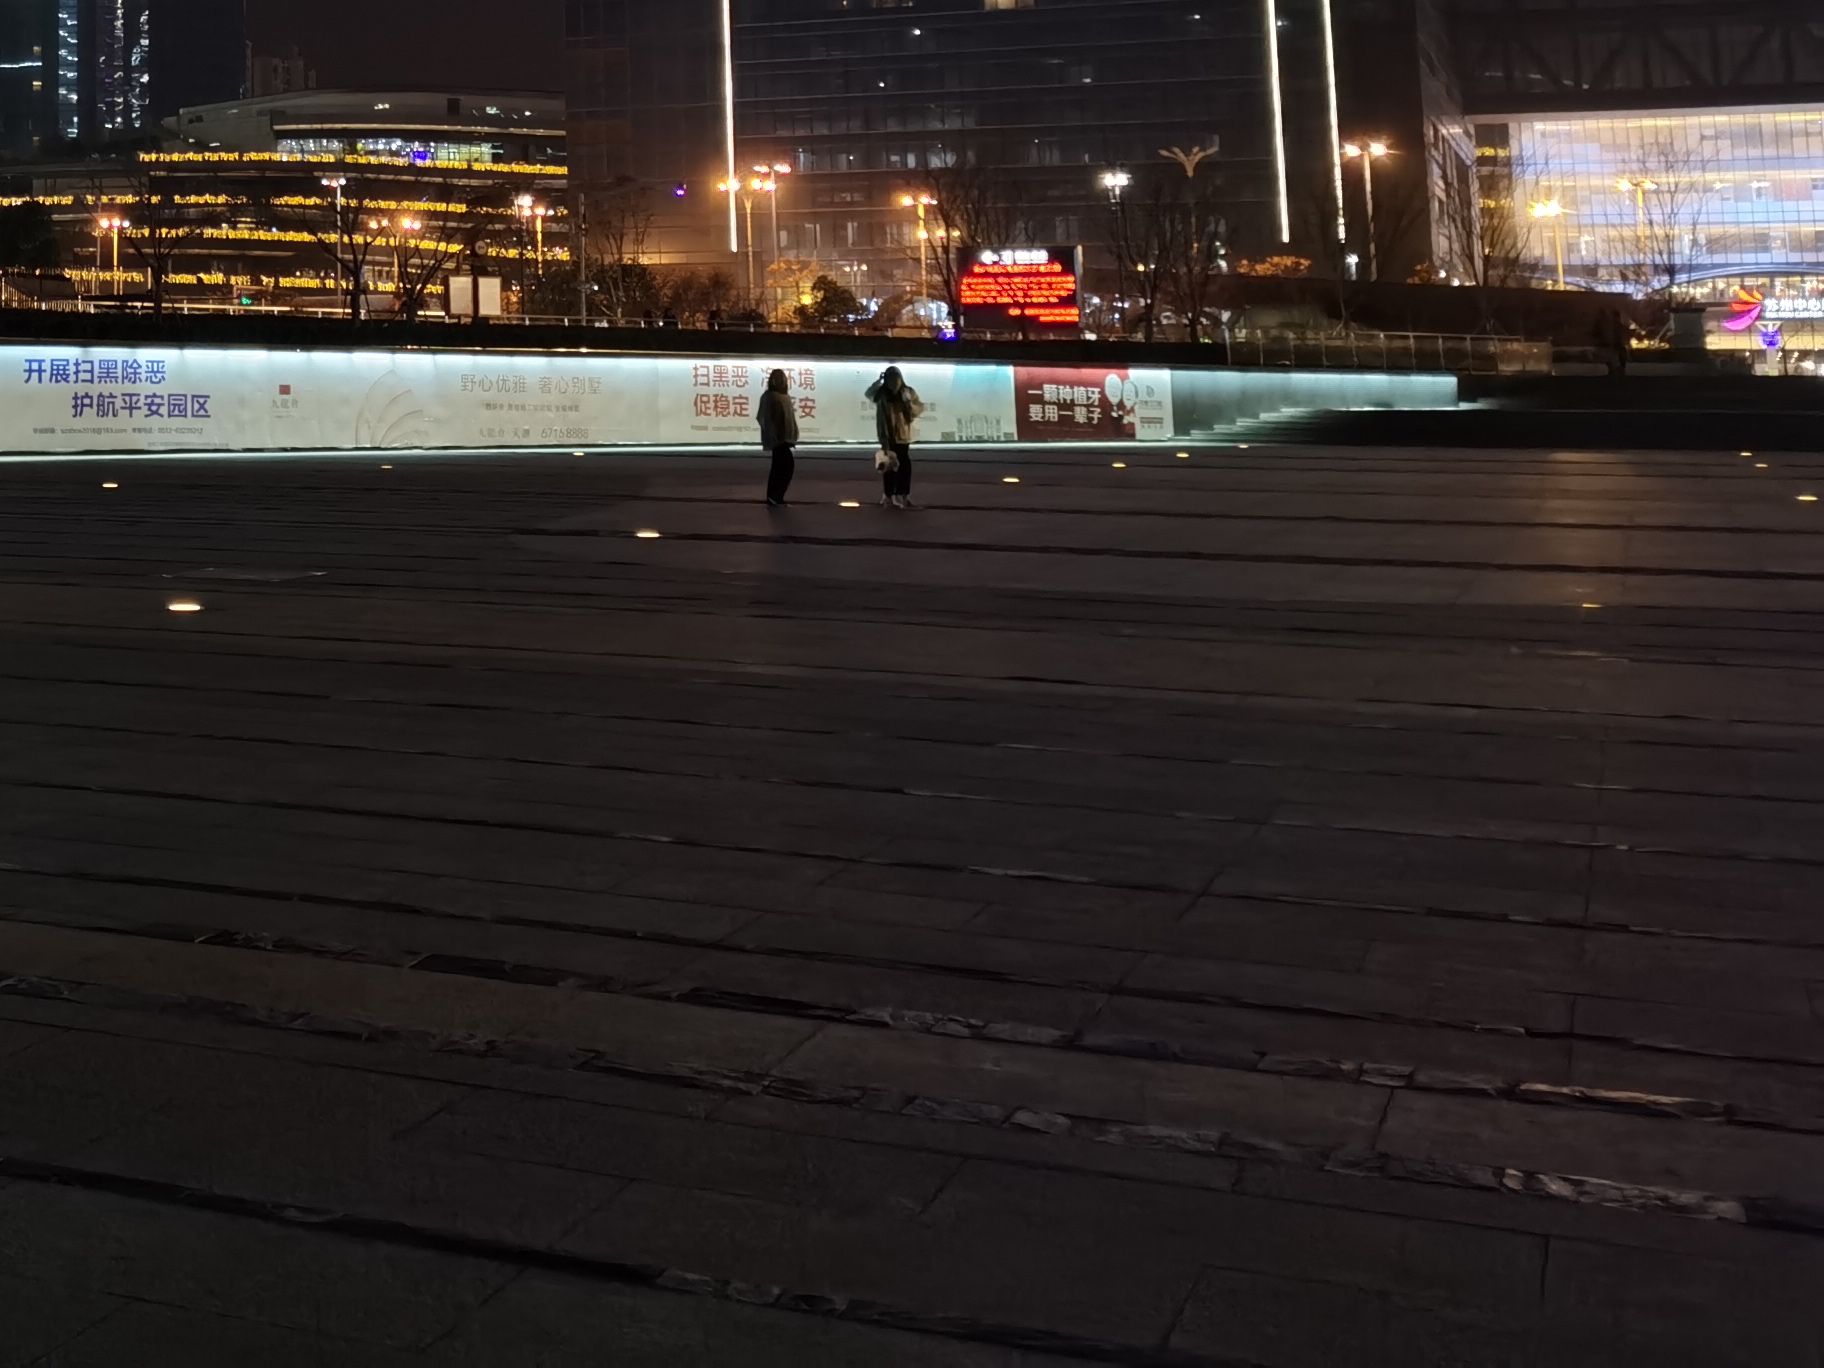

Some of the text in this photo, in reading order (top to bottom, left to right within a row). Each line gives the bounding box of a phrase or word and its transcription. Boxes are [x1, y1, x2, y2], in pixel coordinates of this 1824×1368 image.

[1764, 297, 1824, 312] 苏州中心
[23, 358, 167, 385] 开展扫黑除恶
[692, 363, 749, 388] 扫黑恶
[460, 373, 603, 395] 野心优雅 奢心别墅
[1027, 383, 1102, 406] 一颗种植牙
[71, 391, 211, 419] 护航平安园区
[694, 392, 750, 418] 促稳定
[1028, 404, 1102, 425] 要用一辈子
